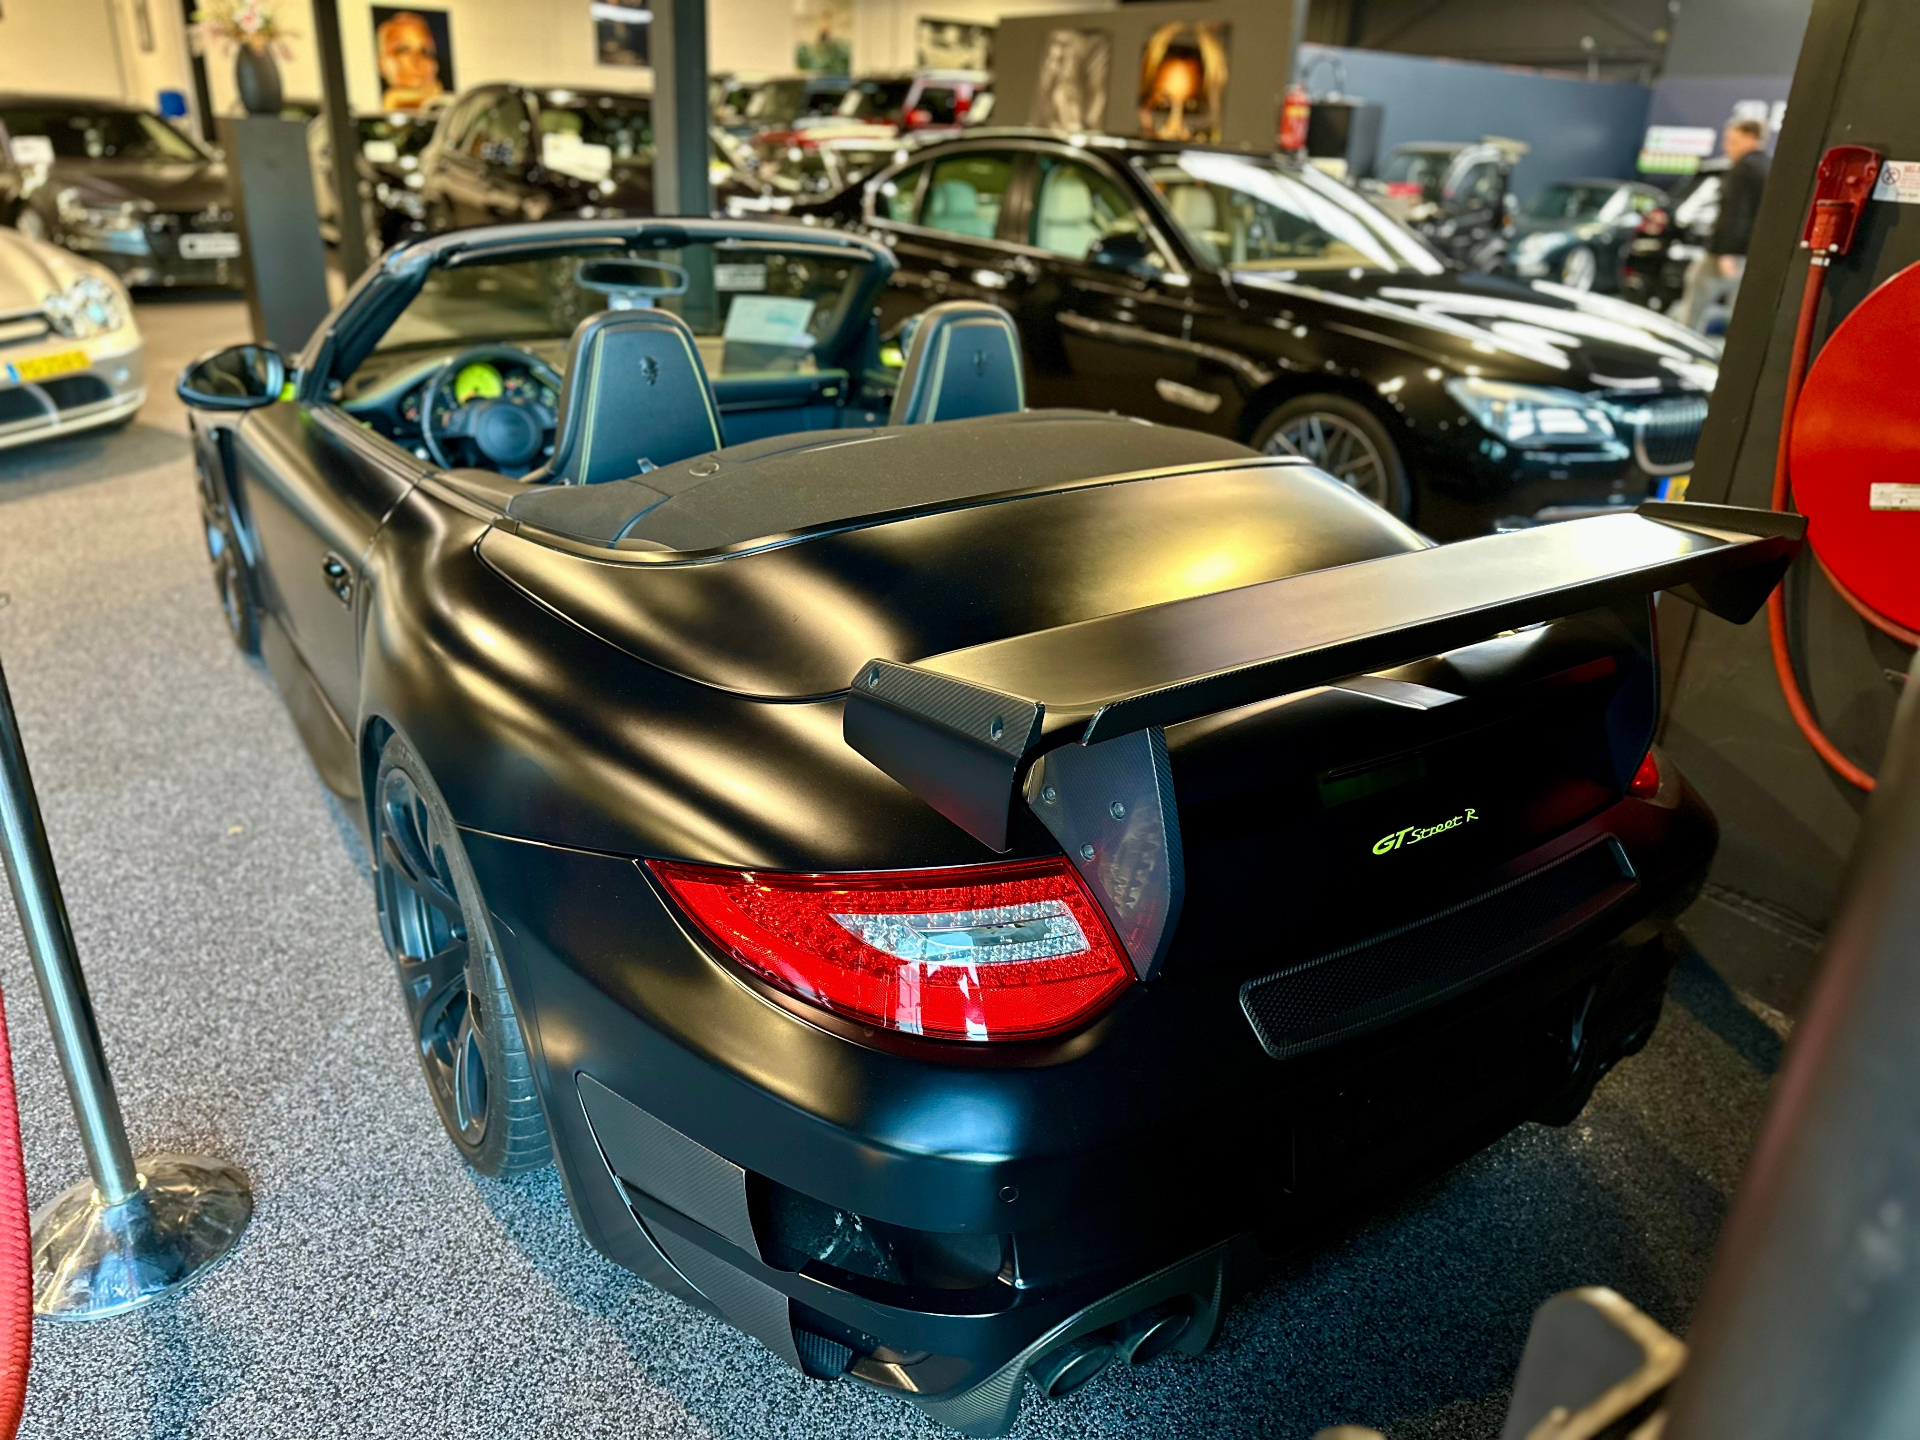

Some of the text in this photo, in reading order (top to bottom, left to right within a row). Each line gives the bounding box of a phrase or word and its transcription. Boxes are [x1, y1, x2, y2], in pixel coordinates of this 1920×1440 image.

[1372, 808, 1479, 855] GT Street R
